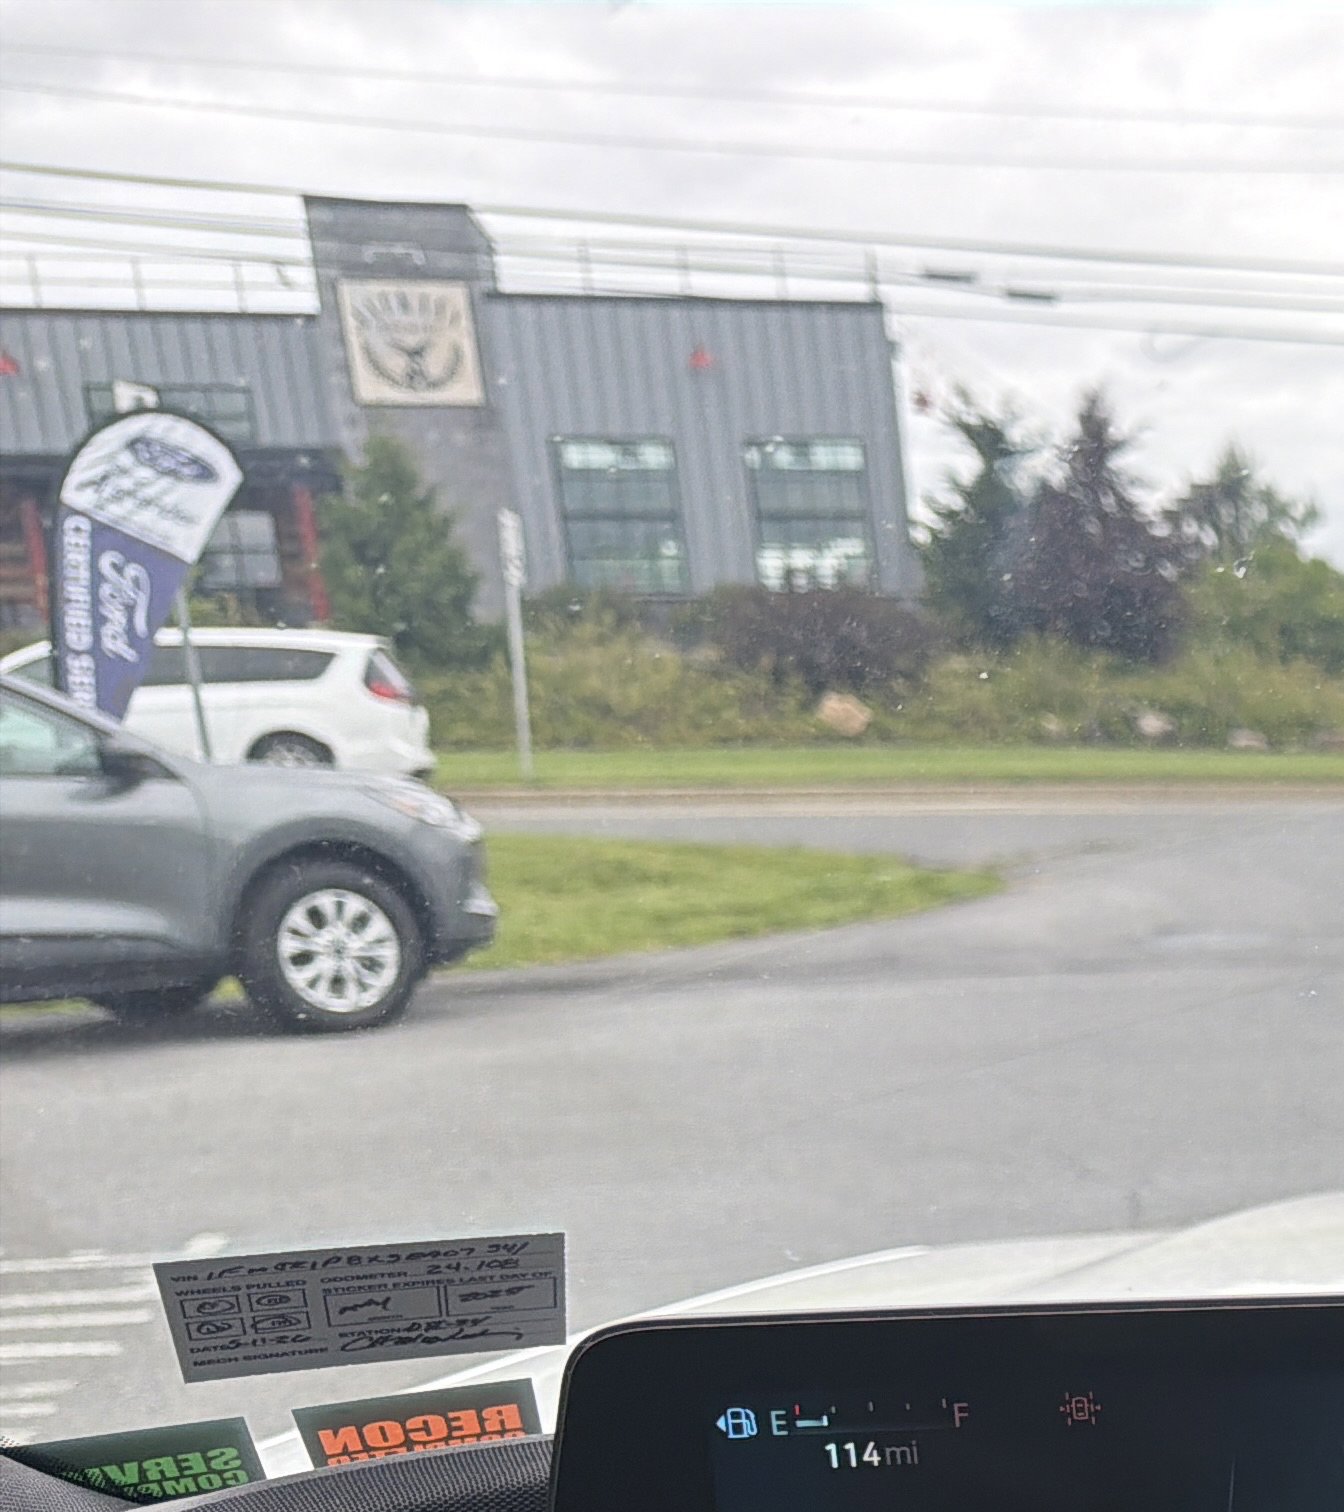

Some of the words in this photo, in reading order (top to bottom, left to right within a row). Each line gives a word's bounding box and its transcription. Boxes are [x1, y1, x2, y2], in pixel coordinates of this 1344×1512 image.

[62, 514, 94, 652] CERTIFIED
[98, 551, 150, 663] Ford
[170, 1274, 199, 1283] VIN
[320, 1270, 408, 1284] ODOMETER
[322, 1282, 388, 1294] STICKER
[392, 1277, 458, 1289] EXPIRES
[460, 1274, 497, 1283] LAST
[500, 1272, 528, 1281] DAY
[174, 1284, 242, 1297] WHEELS
[245, 1279, 307, 1291] PULLED
[338, 1326, 401, 1338] STATION
[193, 1356, 239, 1367] MECH
[242, 1347, 329, 1362] SIGNATURE
[770, 1409, 789, 1436] E
[952, 1403, 970, 1427] F
